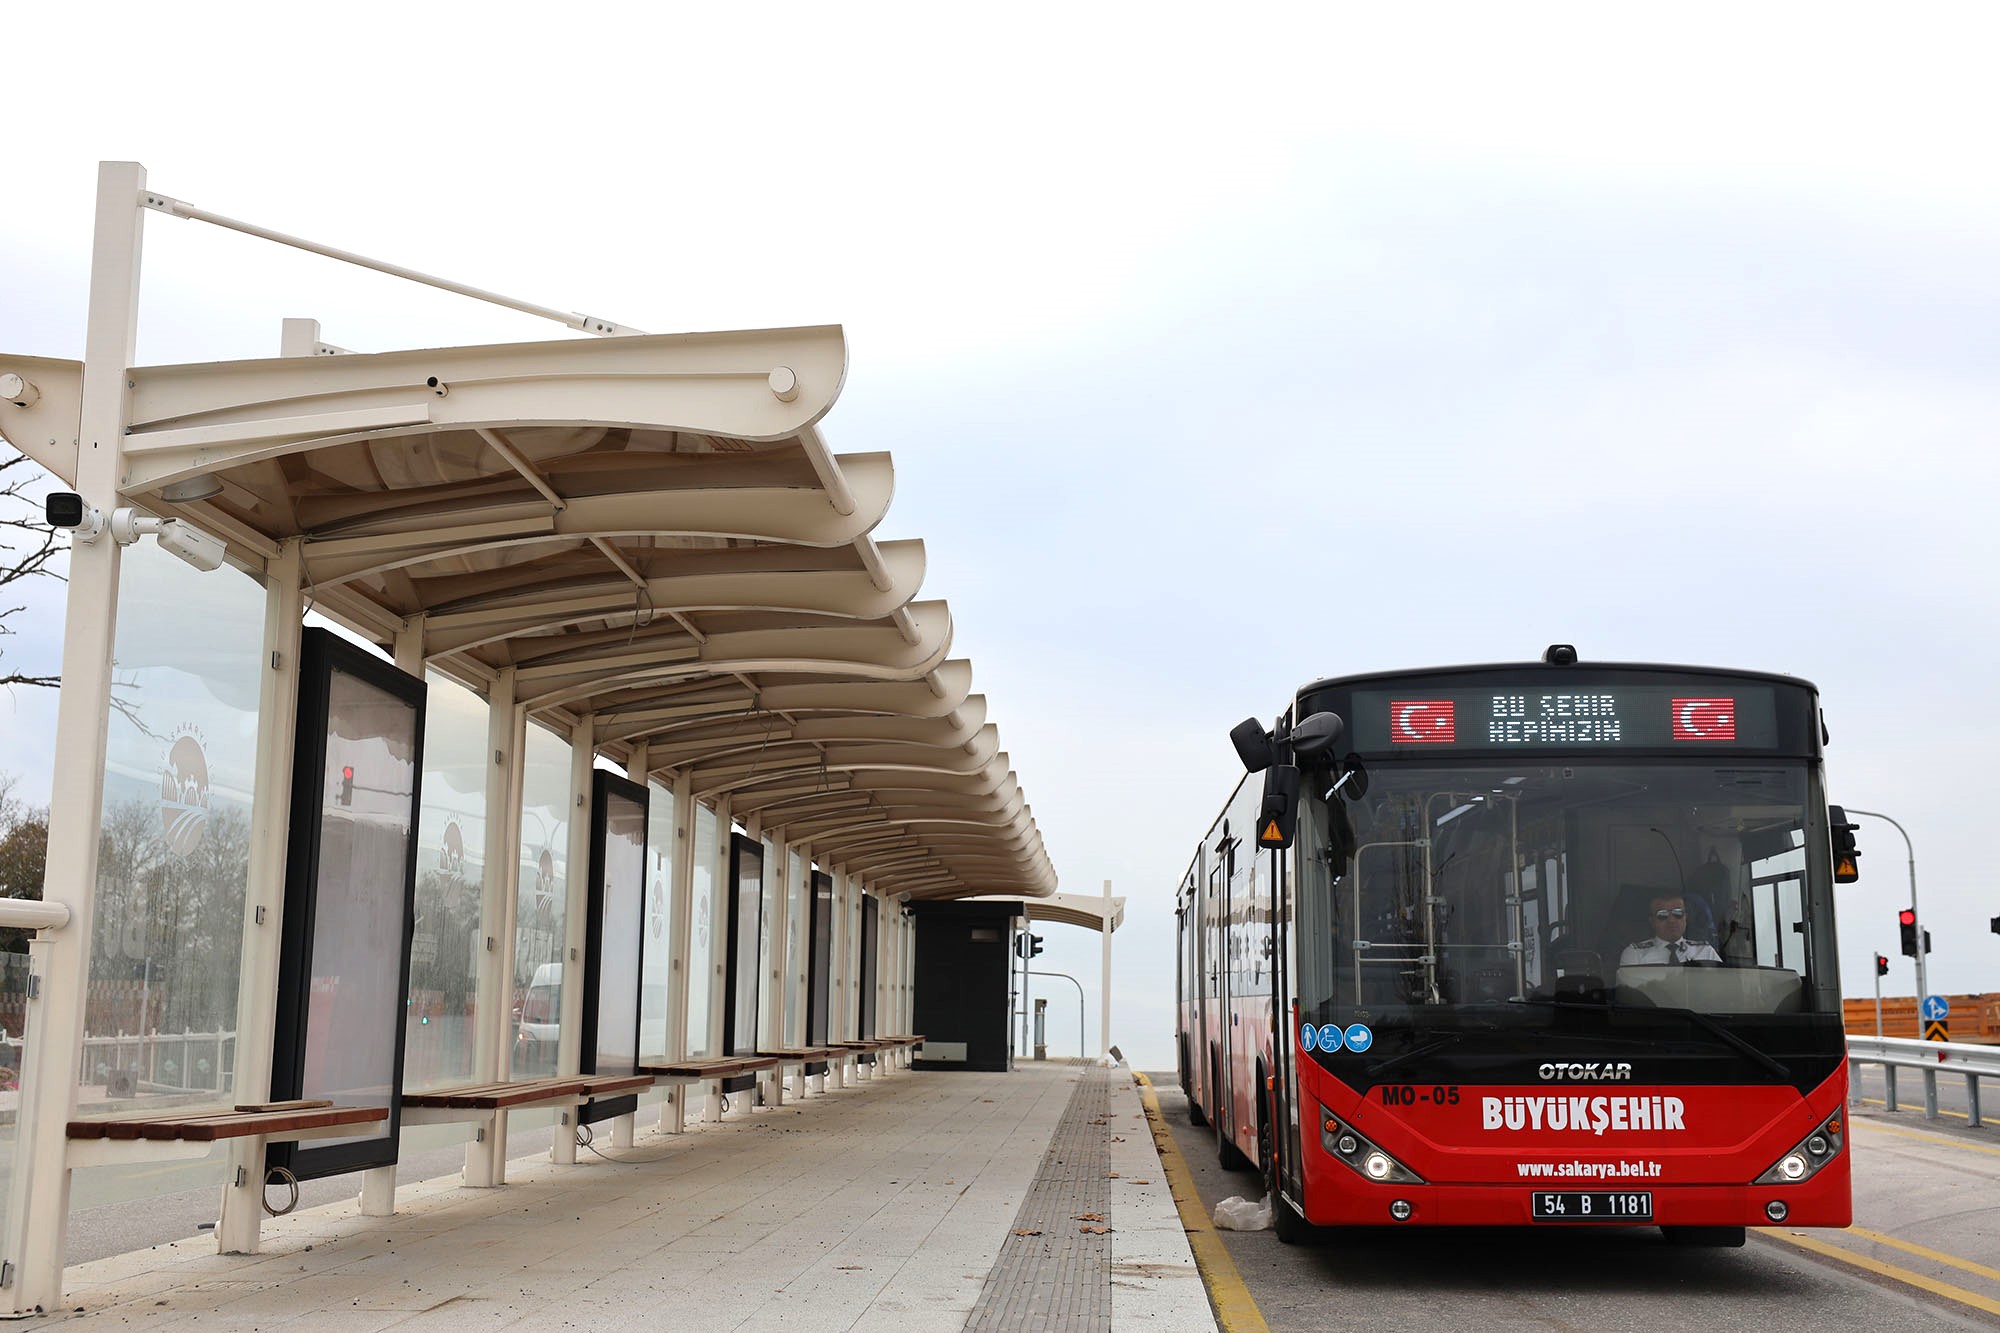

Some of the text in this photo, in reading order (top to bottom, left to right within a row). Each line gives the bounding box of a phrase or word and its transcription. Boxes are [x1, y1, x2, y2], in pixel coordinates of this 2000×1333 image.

[1493, 696, 1525, 717] BU
[1538, 1063, 1632, 1080] OTOKAR
[1481, 1096, 1686, 1136] BÜYÜKŞEHİR
[1516, 1160, 1662, 1179] www.sakarya.bel.tr
[1544, 1195, 1648, 1214] 54 B 1181
